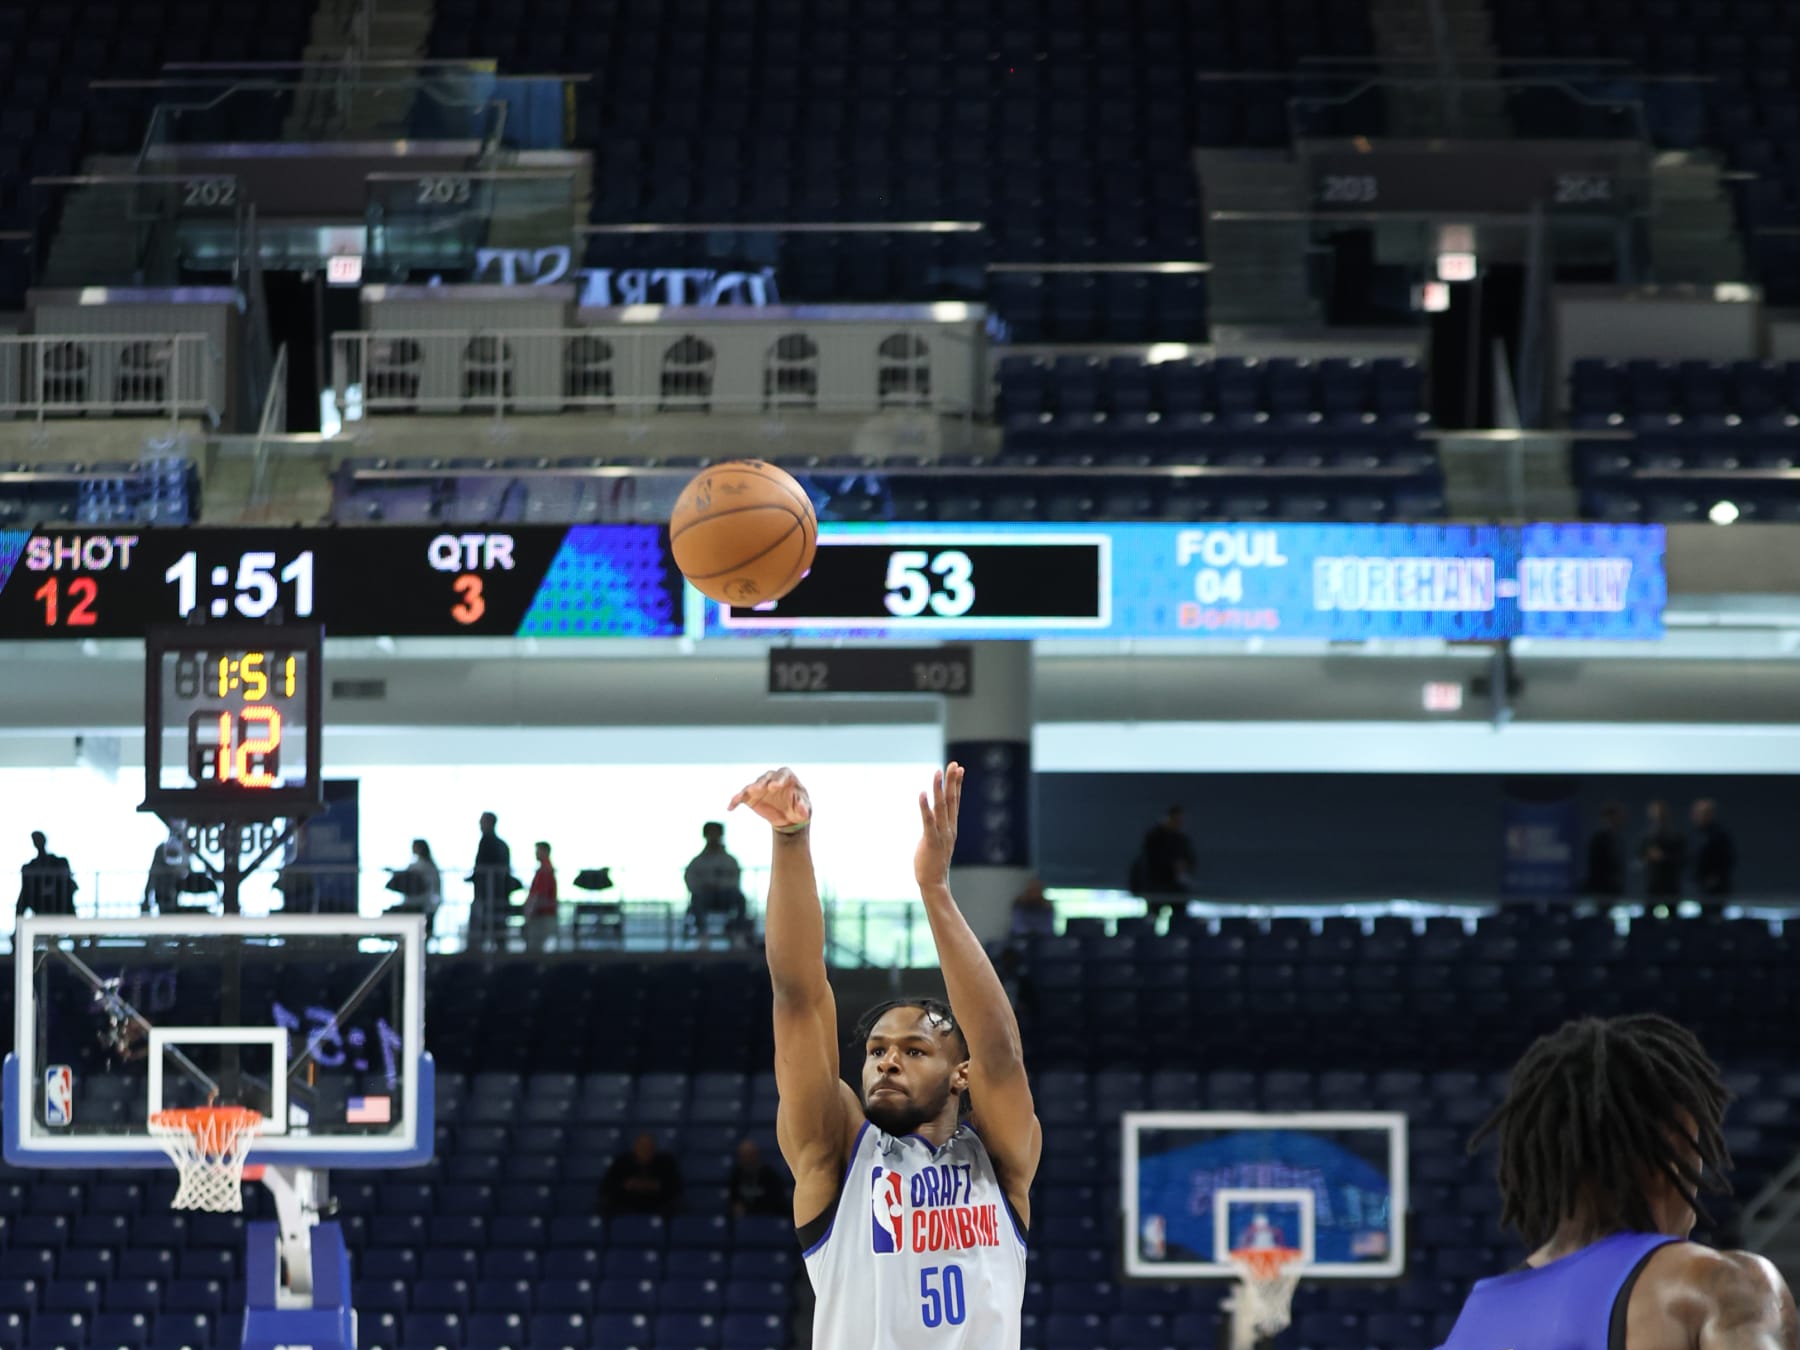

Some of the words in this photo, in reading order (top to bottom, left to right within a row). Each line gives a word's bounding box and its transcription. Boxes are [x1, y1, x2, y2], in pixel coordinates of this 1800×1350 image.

[184, 179, 236, 206] 202
[417, 176, 471, 203] 203
[25, 535, 139, 571] SHOT
[427, 533, 516, 573] QTR
[1177, 529, 1288, 568] FOUL
[35, 576, 98, 627] 12
[165, 550, 314, 619] 1:51
[450, 574, 486, 625] 3
[883, 550, 975, 617] 53
[1194, 568, 1243, 605] 04
[218, 653, 297, 701] 1:51
[774, 663, 828, 690] 102
[913, 663, 966, 690] 103
[218, 706, 281, 788] 12
[911, 1164, 971, 1207] DRAFT
[912, 1204, 1000, 1253] COMBINE
[920, 1264, 966, 1328] 50
